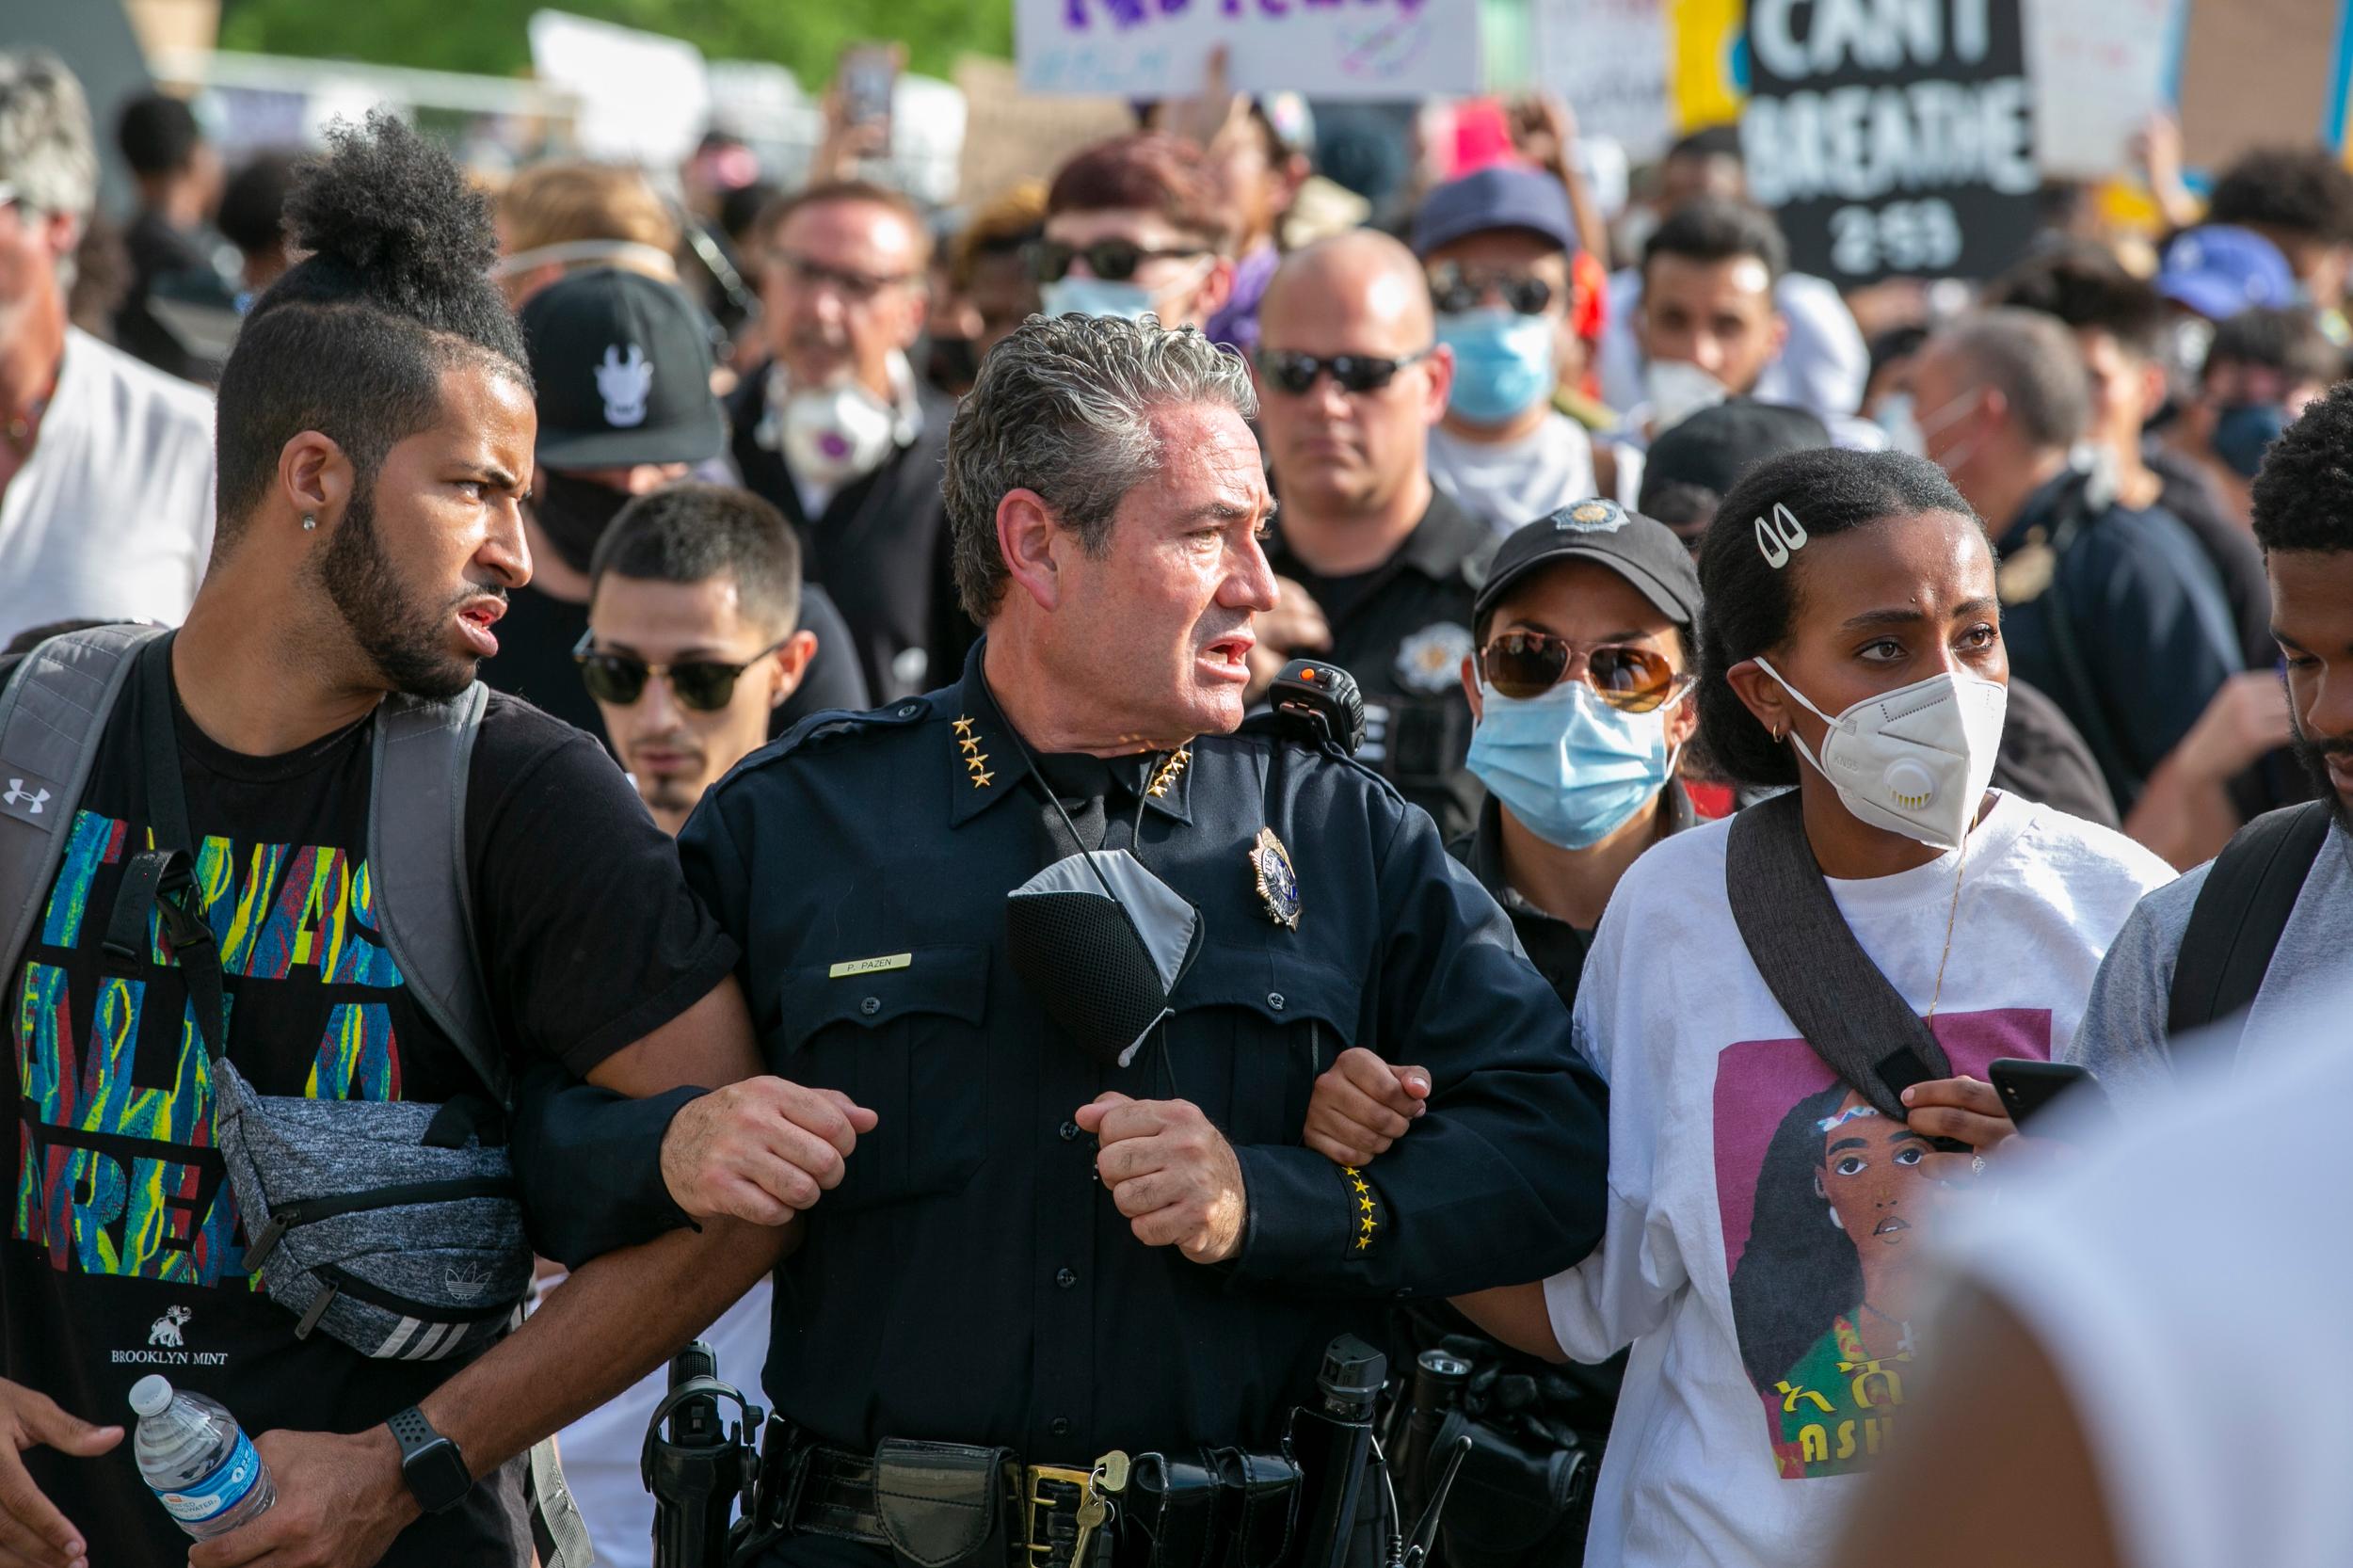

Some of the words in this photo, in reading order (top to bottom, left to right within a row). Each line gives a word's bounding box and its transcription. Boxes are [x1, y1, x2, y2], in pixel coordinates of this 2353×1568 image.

[1739, 75, 2041, 209] BREATHE
[1835, 755, 1859, 772] KN95
[861, 958, 892, 969] PAZEN
[111, 1350, 189, 1365] BROOKLYN
[193, 1352, 228, 1365] MINT
